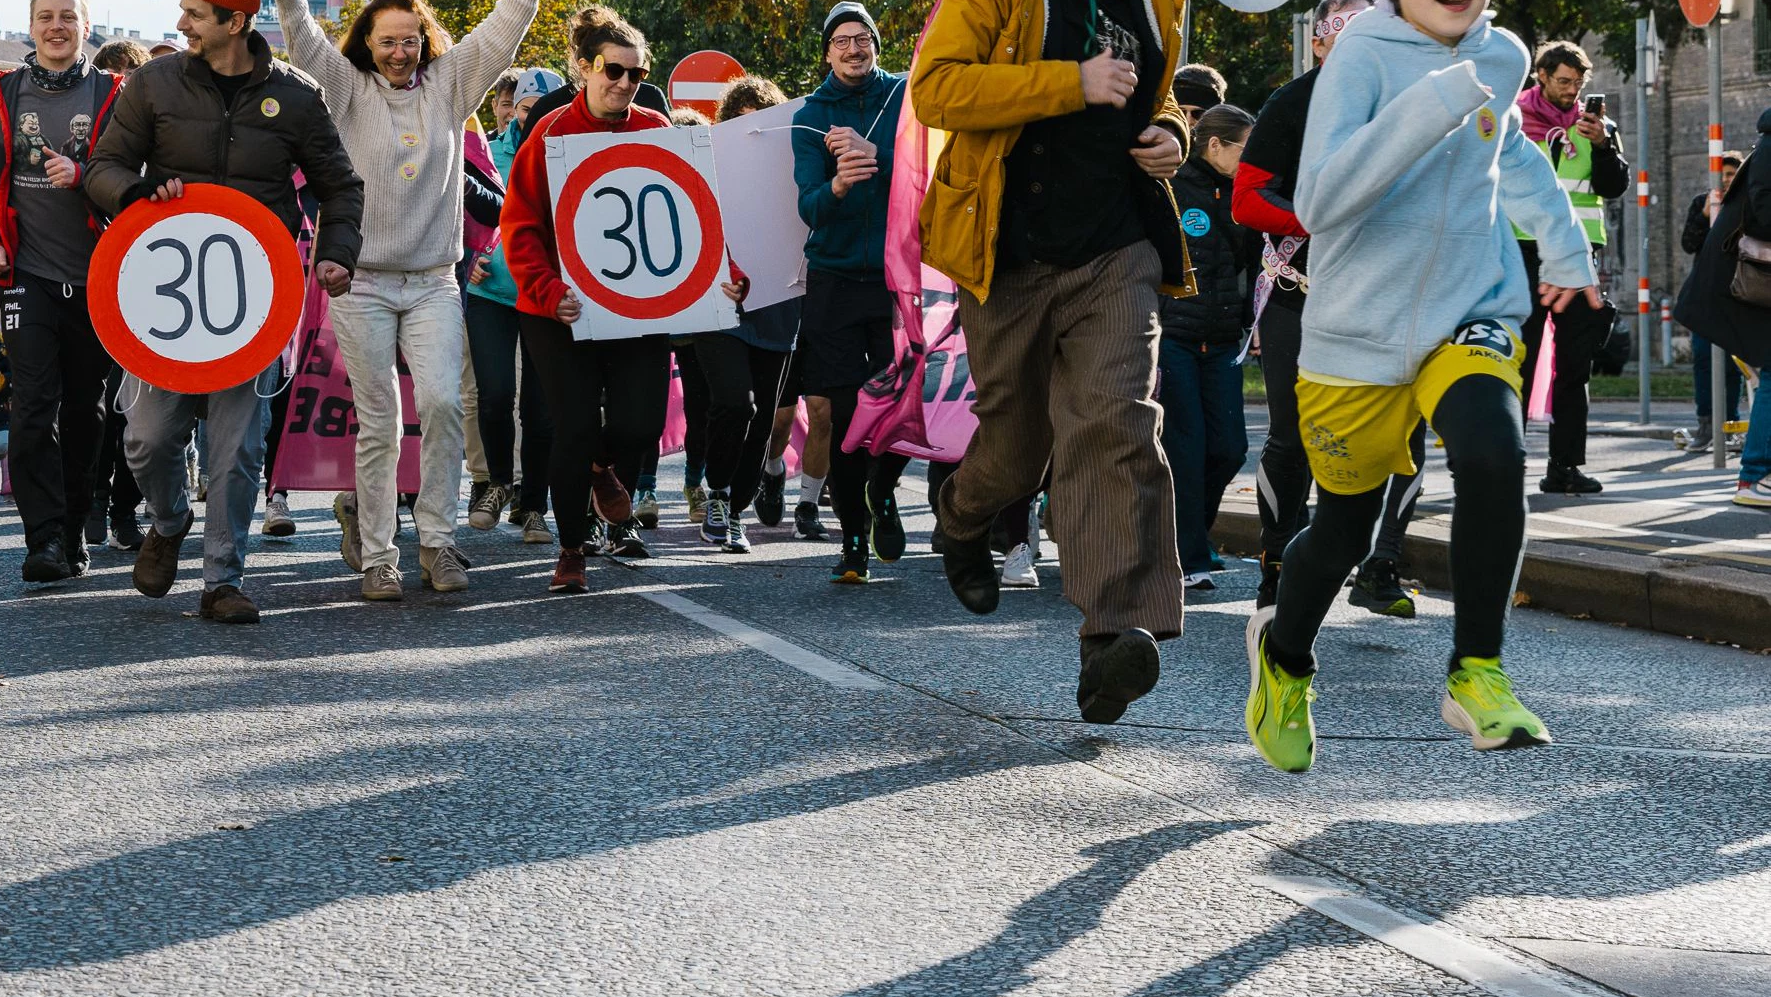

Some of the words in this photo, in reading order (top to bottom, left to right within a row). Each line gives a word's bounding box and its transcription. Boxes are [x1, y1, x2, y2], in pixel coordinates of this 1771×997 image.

[593, 184, 682, 280] 30
[147, 234, 246, 340] 30
[5, 303, 21, 311] PHIL
[6, 314, 19, 330] 21
[1467, 349, 1502, 363] JAKO
